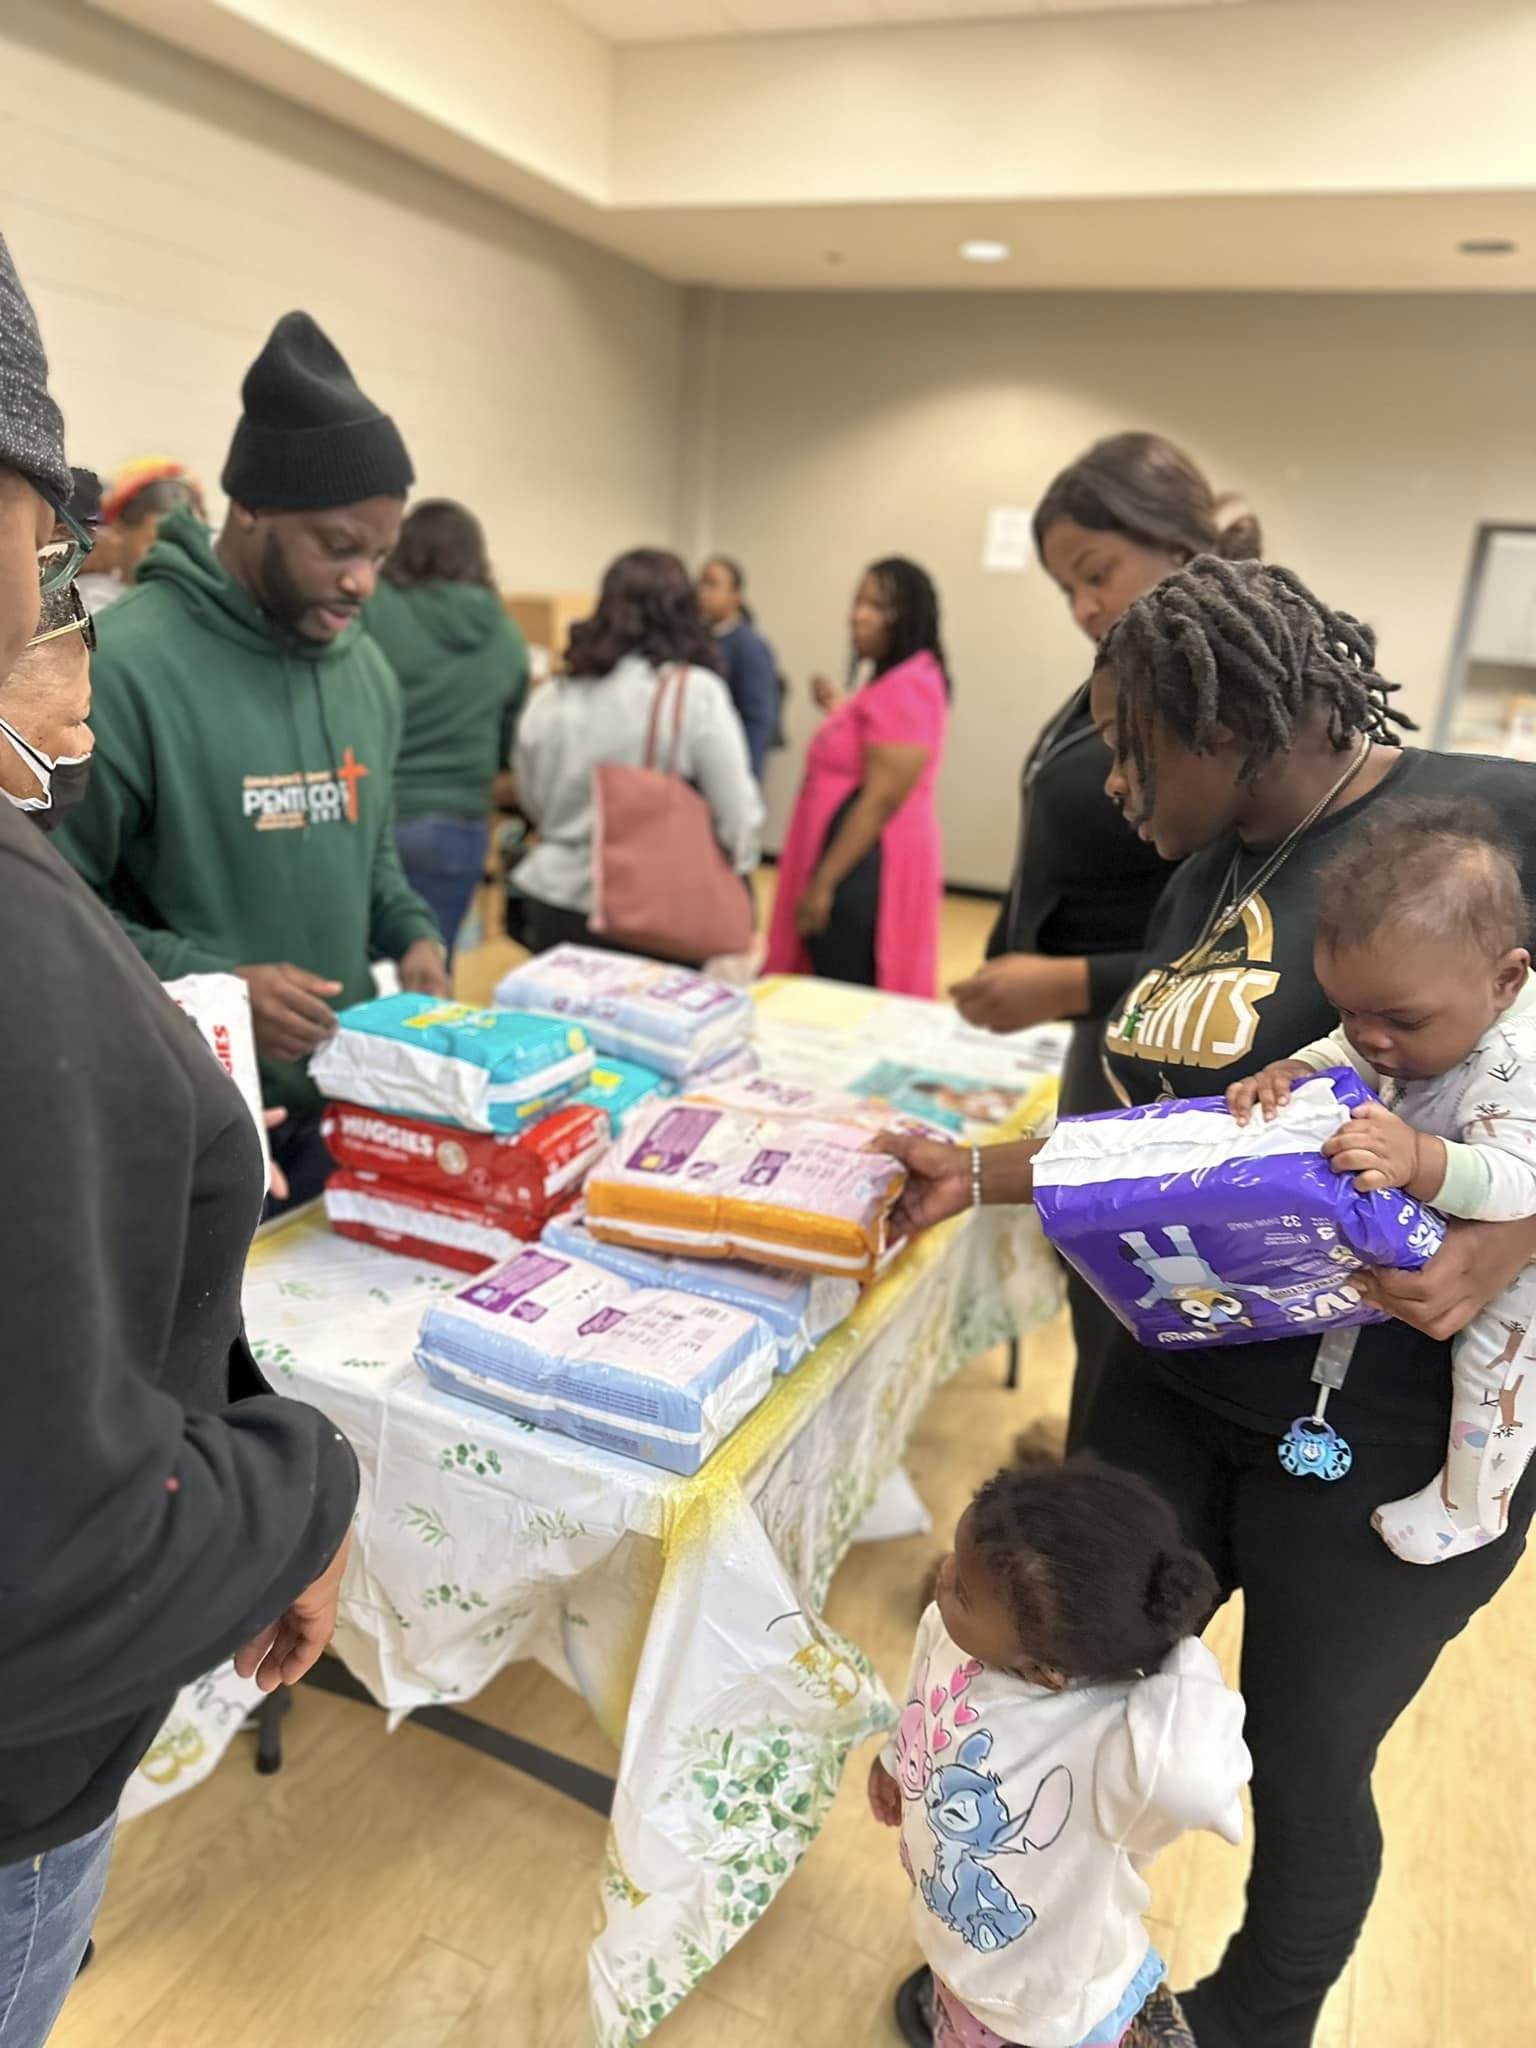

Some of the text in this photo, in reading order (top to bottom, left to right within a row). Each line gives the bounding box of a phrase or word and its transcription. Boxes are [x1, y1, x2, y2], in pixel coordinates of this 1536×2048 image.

[341, 1115, 435, 1156] HUGGIES
[1280, 1214, 1303, 1228] 32
[1398, 1204, 1415, 1225] 3
